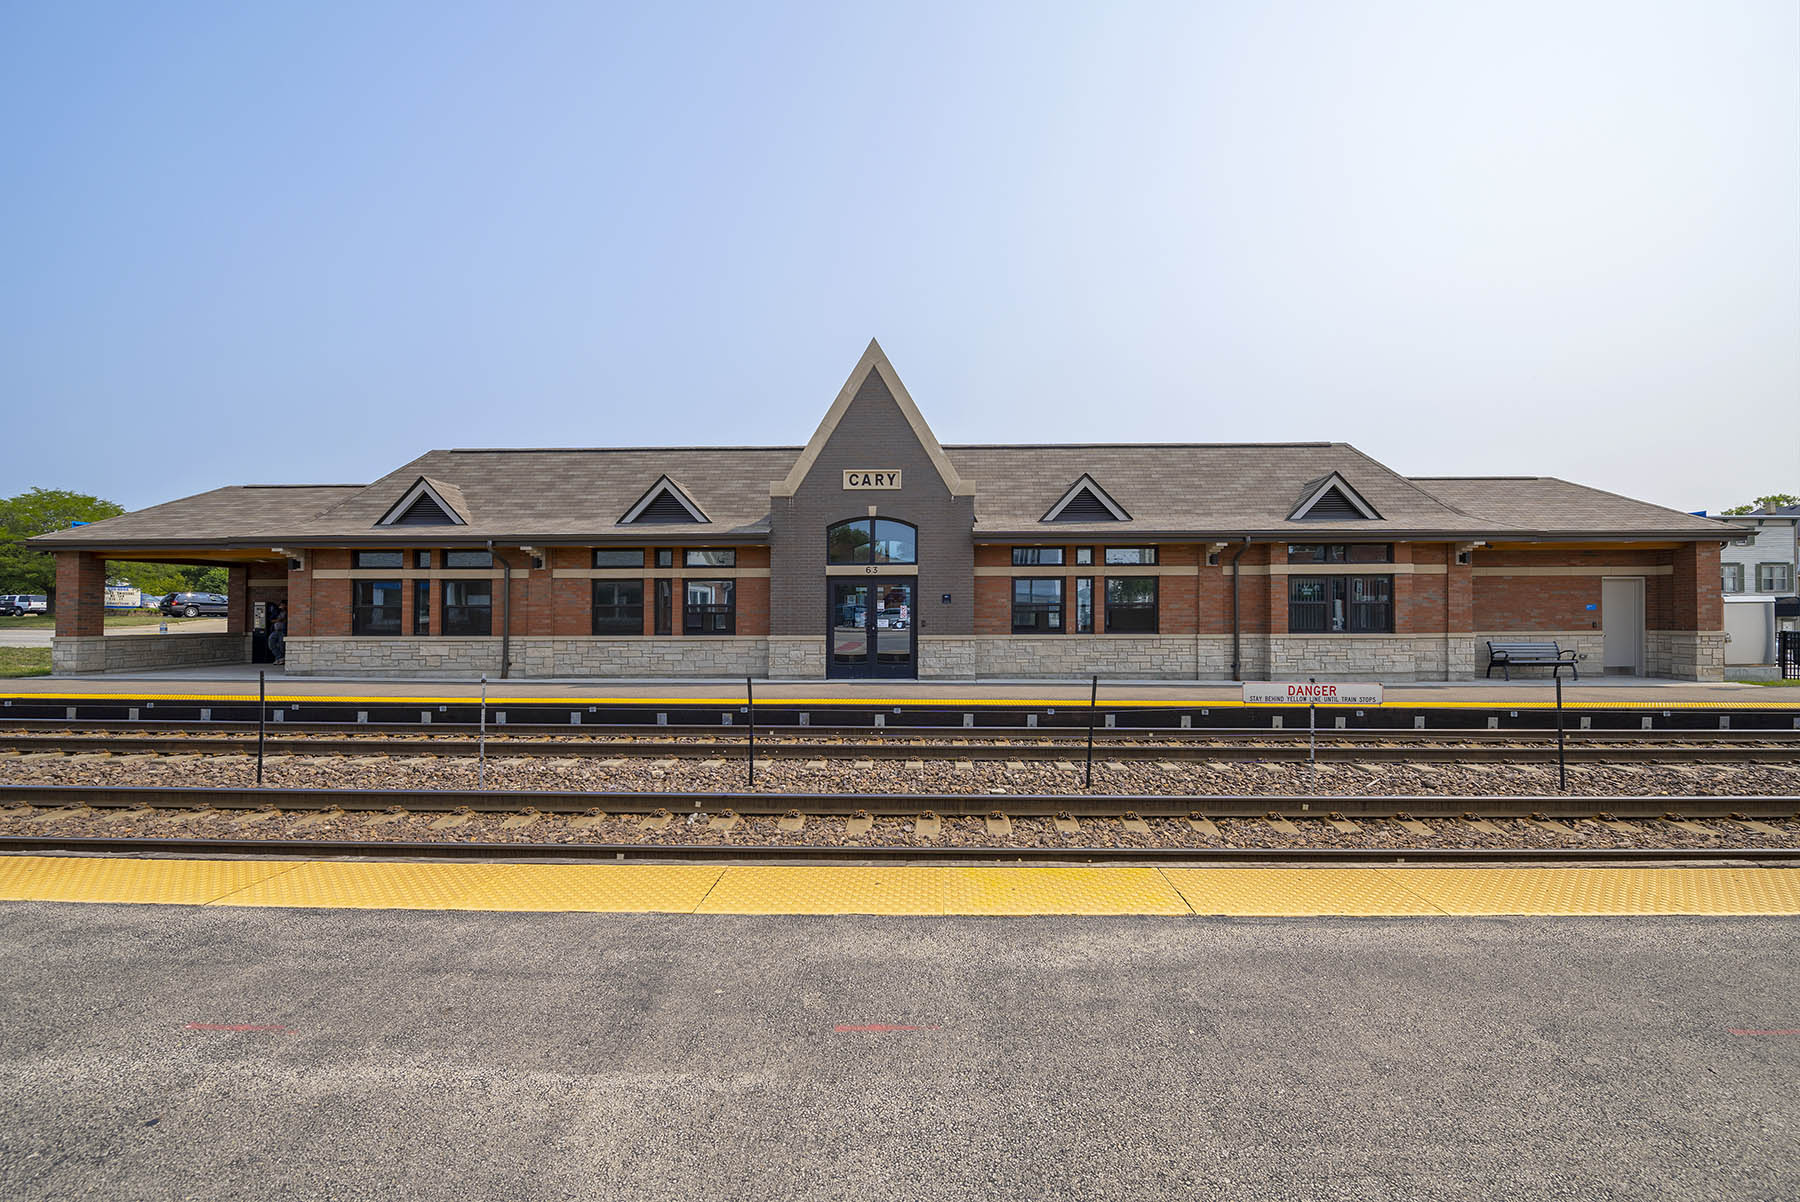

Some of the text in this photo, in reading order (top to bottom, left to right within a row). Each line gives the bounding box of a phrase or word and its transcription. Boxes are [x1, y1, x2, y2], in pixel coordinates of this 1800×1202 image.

[849, 473, 897, 486] CARY
[865, 566, 878, 574] 63
[1288, 685, 1337, 696] DANGER
